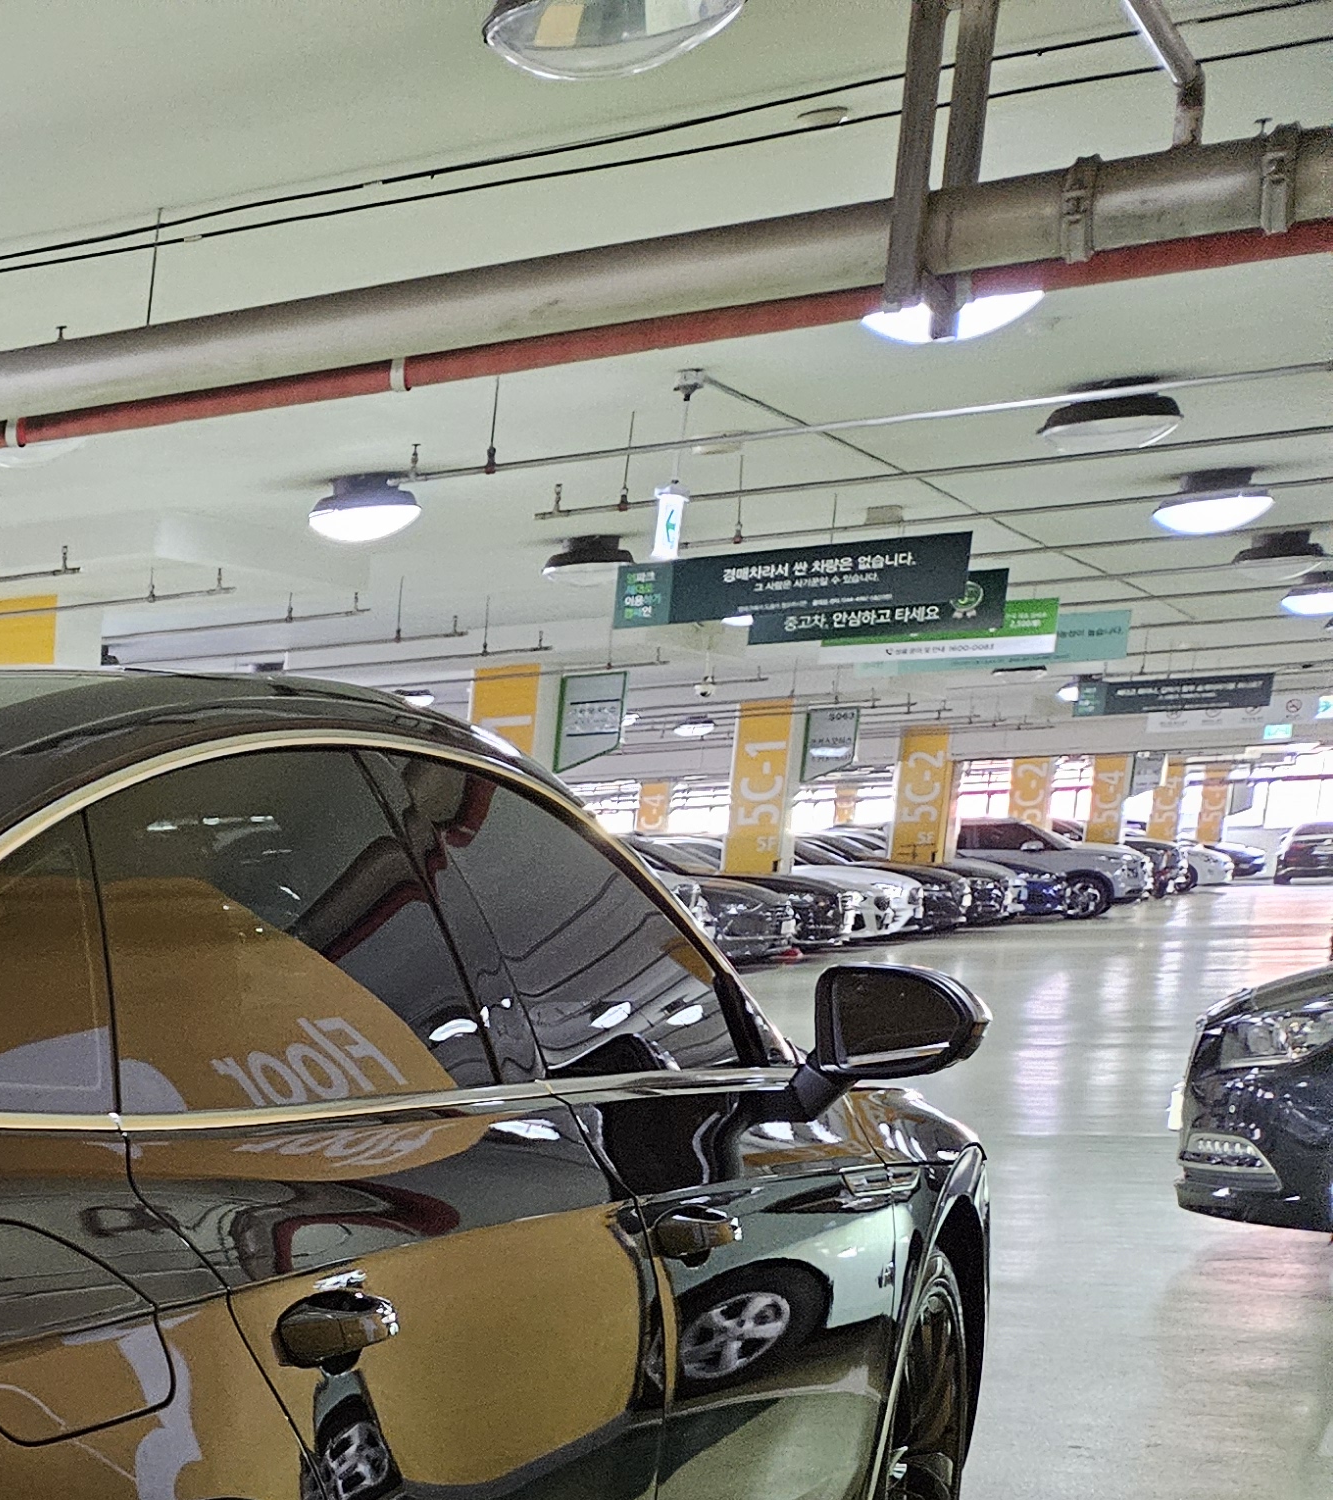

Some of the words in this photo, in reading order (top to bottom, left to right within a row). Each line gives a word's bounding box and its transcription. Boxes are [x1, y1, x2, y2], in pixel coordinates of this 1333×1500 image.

[722, 563, 789, 583] 경매차라서
[792, 561, 808, 577] 싼
[811, 556, 853, 574] 차량은
[857, 551, 916, 570] 없습니다.
[831, 575, 842, 585] 수
[832, 609, 890, 628] 안심하고
[894, 605, 940, 622] 타세요
[737, 741, 786, 826] 5C-1
[901, 751, 944, 823] 5C-2
[1093, 770, 1124, 824] 5C-4
